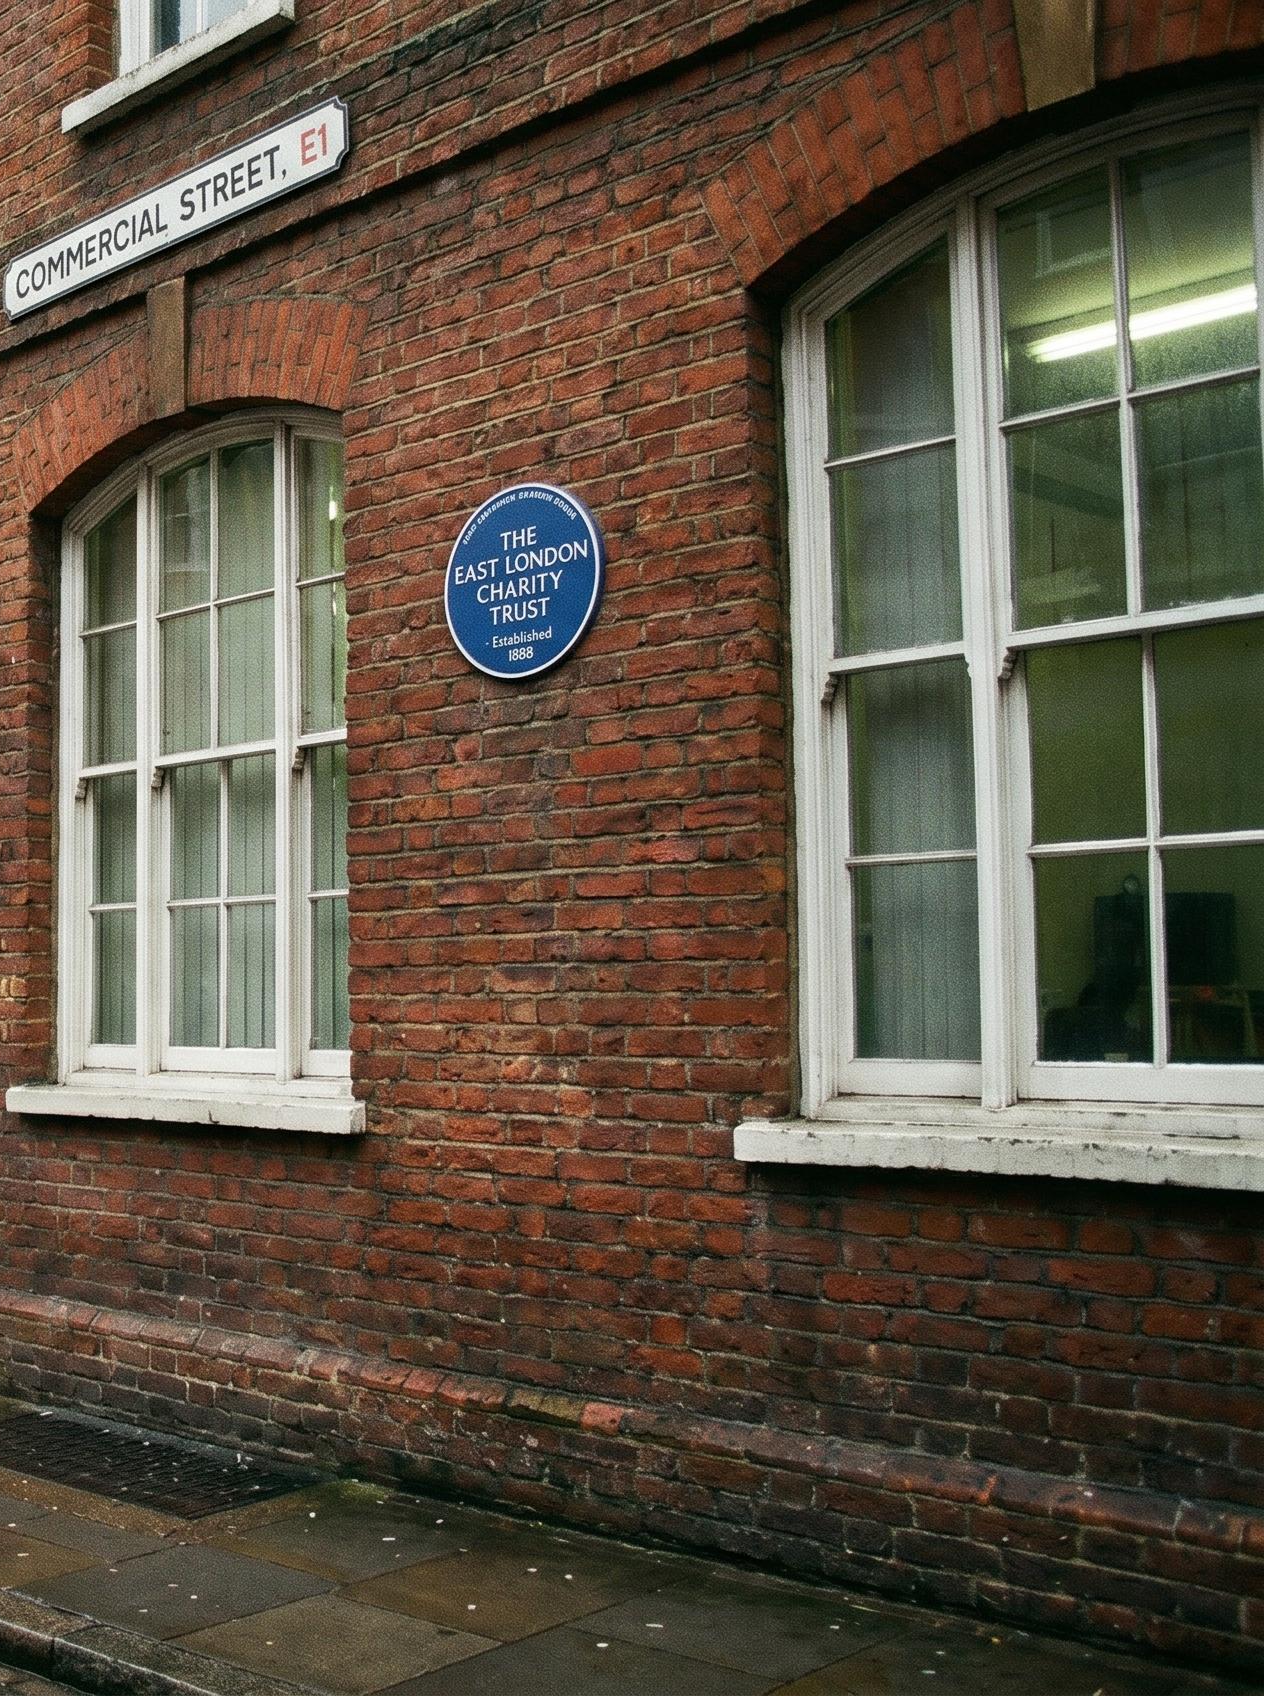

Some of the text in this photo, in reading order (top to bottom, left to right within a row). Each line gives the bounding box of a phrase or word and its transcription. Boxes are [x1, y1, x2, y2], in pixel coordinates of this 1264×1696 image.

[15, 123, 328, 300] COMMERCIAL STREET, E1
[500, 525, 537, 551] THE
[454, 539, 588, 586] EAST LONDON
[476, 569, 563, 604] CHARITY
[489, 597, 550, 626] TRUST
[492, 625, 552, 648] Established
[508, 646, 534, 662] 1888
